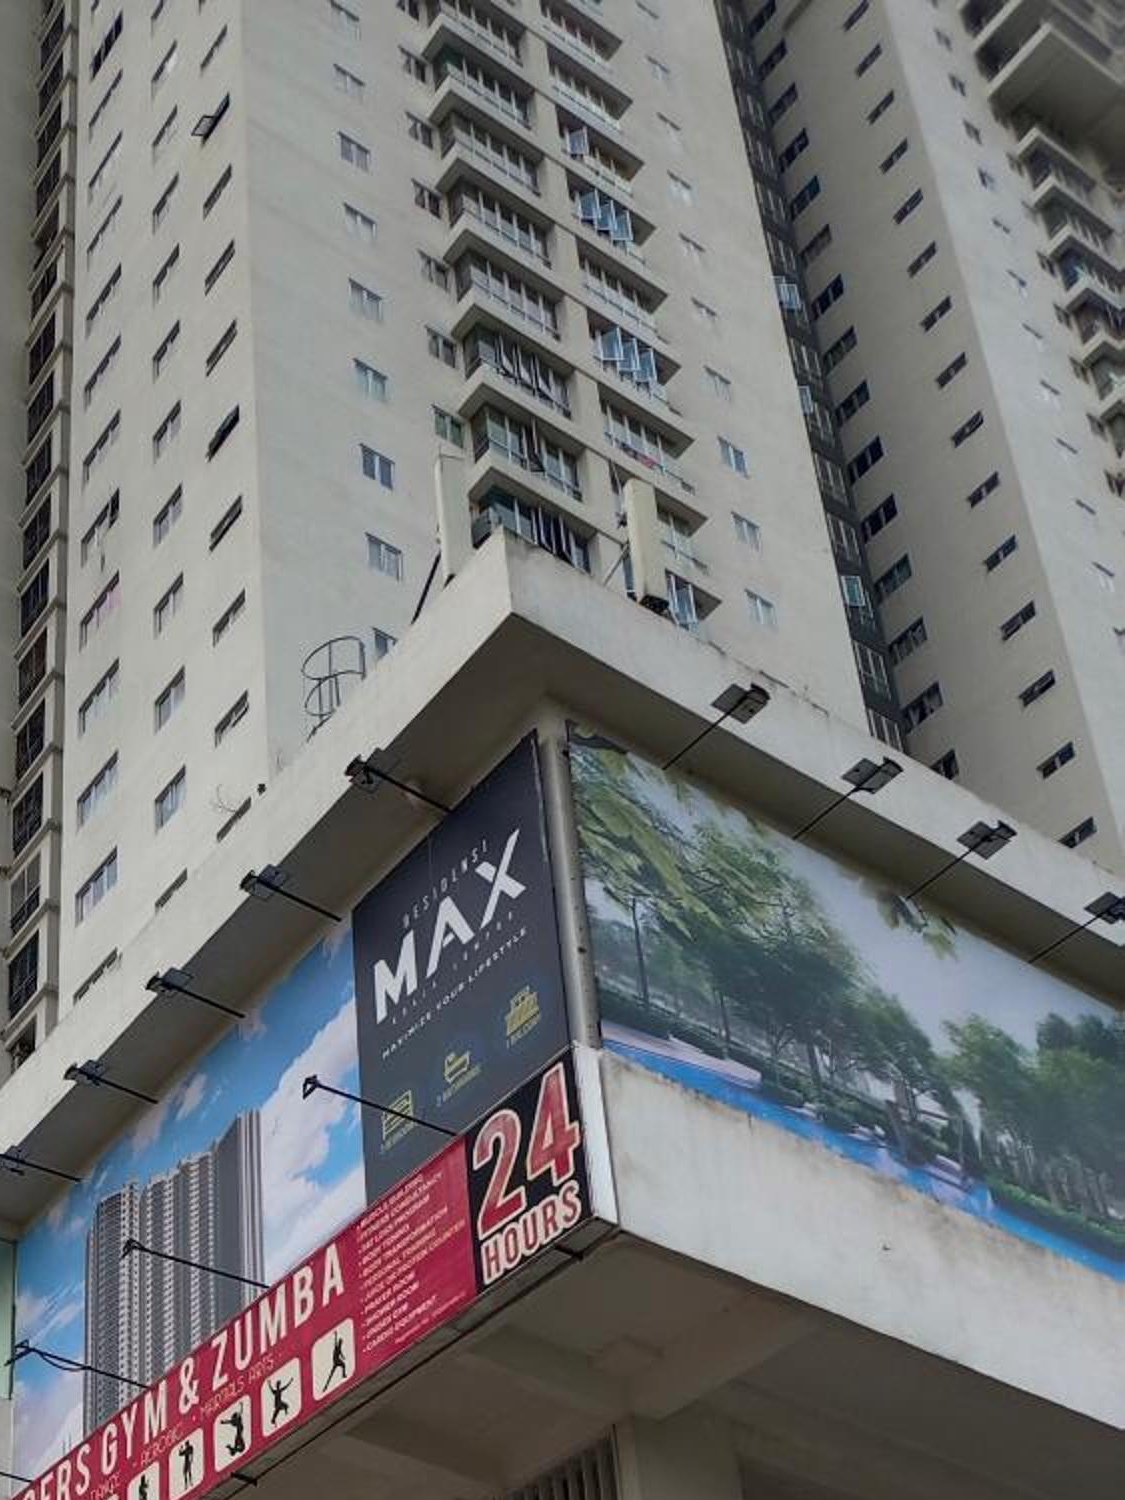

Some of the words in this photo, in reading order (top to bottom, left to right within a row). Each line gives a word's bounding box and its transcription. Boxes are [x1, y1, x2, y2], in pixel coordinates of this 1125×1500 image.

[374, 829, 526, 1024] MAX
[473, 1062, 581, 1240] 24
[480, 1179, 582, 1285] HOURS
[101, 1380, 168, 1474] GYM
[179, 1357, 200, 1414] &
[212, 1246, 345, 1398] ZUMBA
